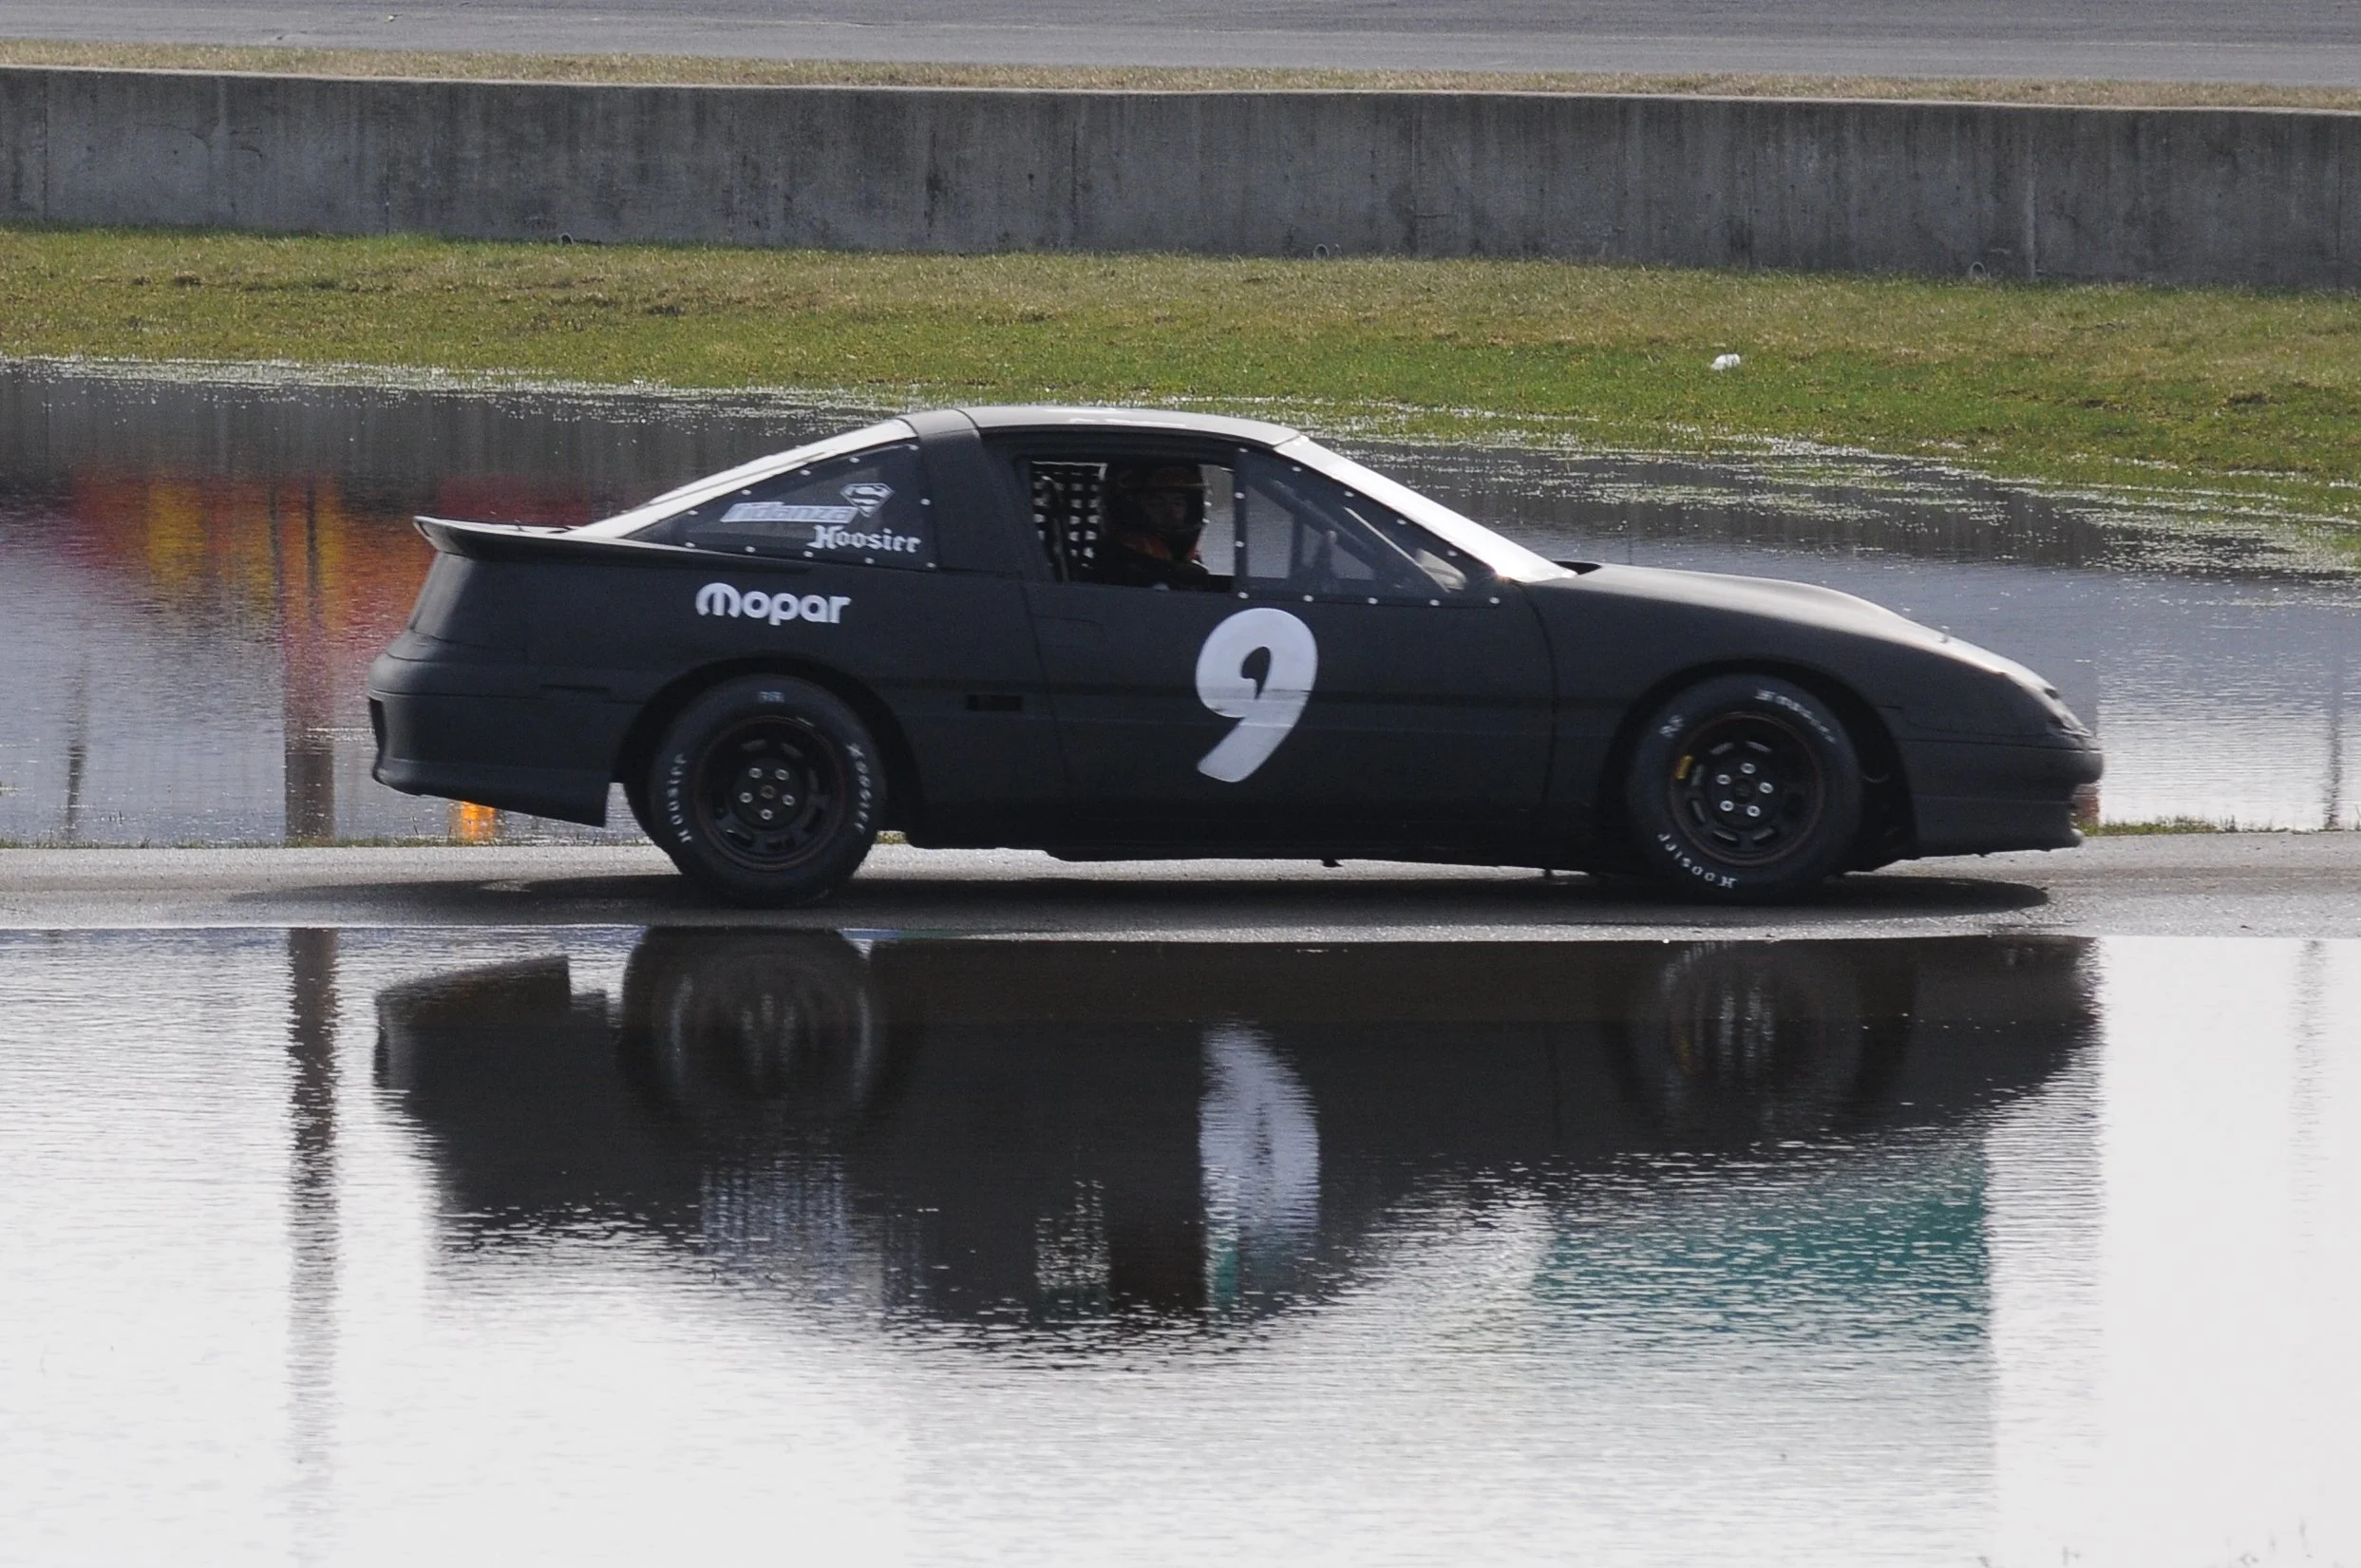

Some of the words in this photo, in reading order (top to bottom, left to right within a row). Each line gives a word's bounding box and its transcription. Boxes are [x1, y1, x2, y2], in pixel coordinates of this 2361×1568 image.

[806, 524, 921, 554] Hoosier
[695, 582, 851, 626] Mopar
[1196, 608, 1318, 782] 9
[1657, 832, 1739, 889] Hoosier
